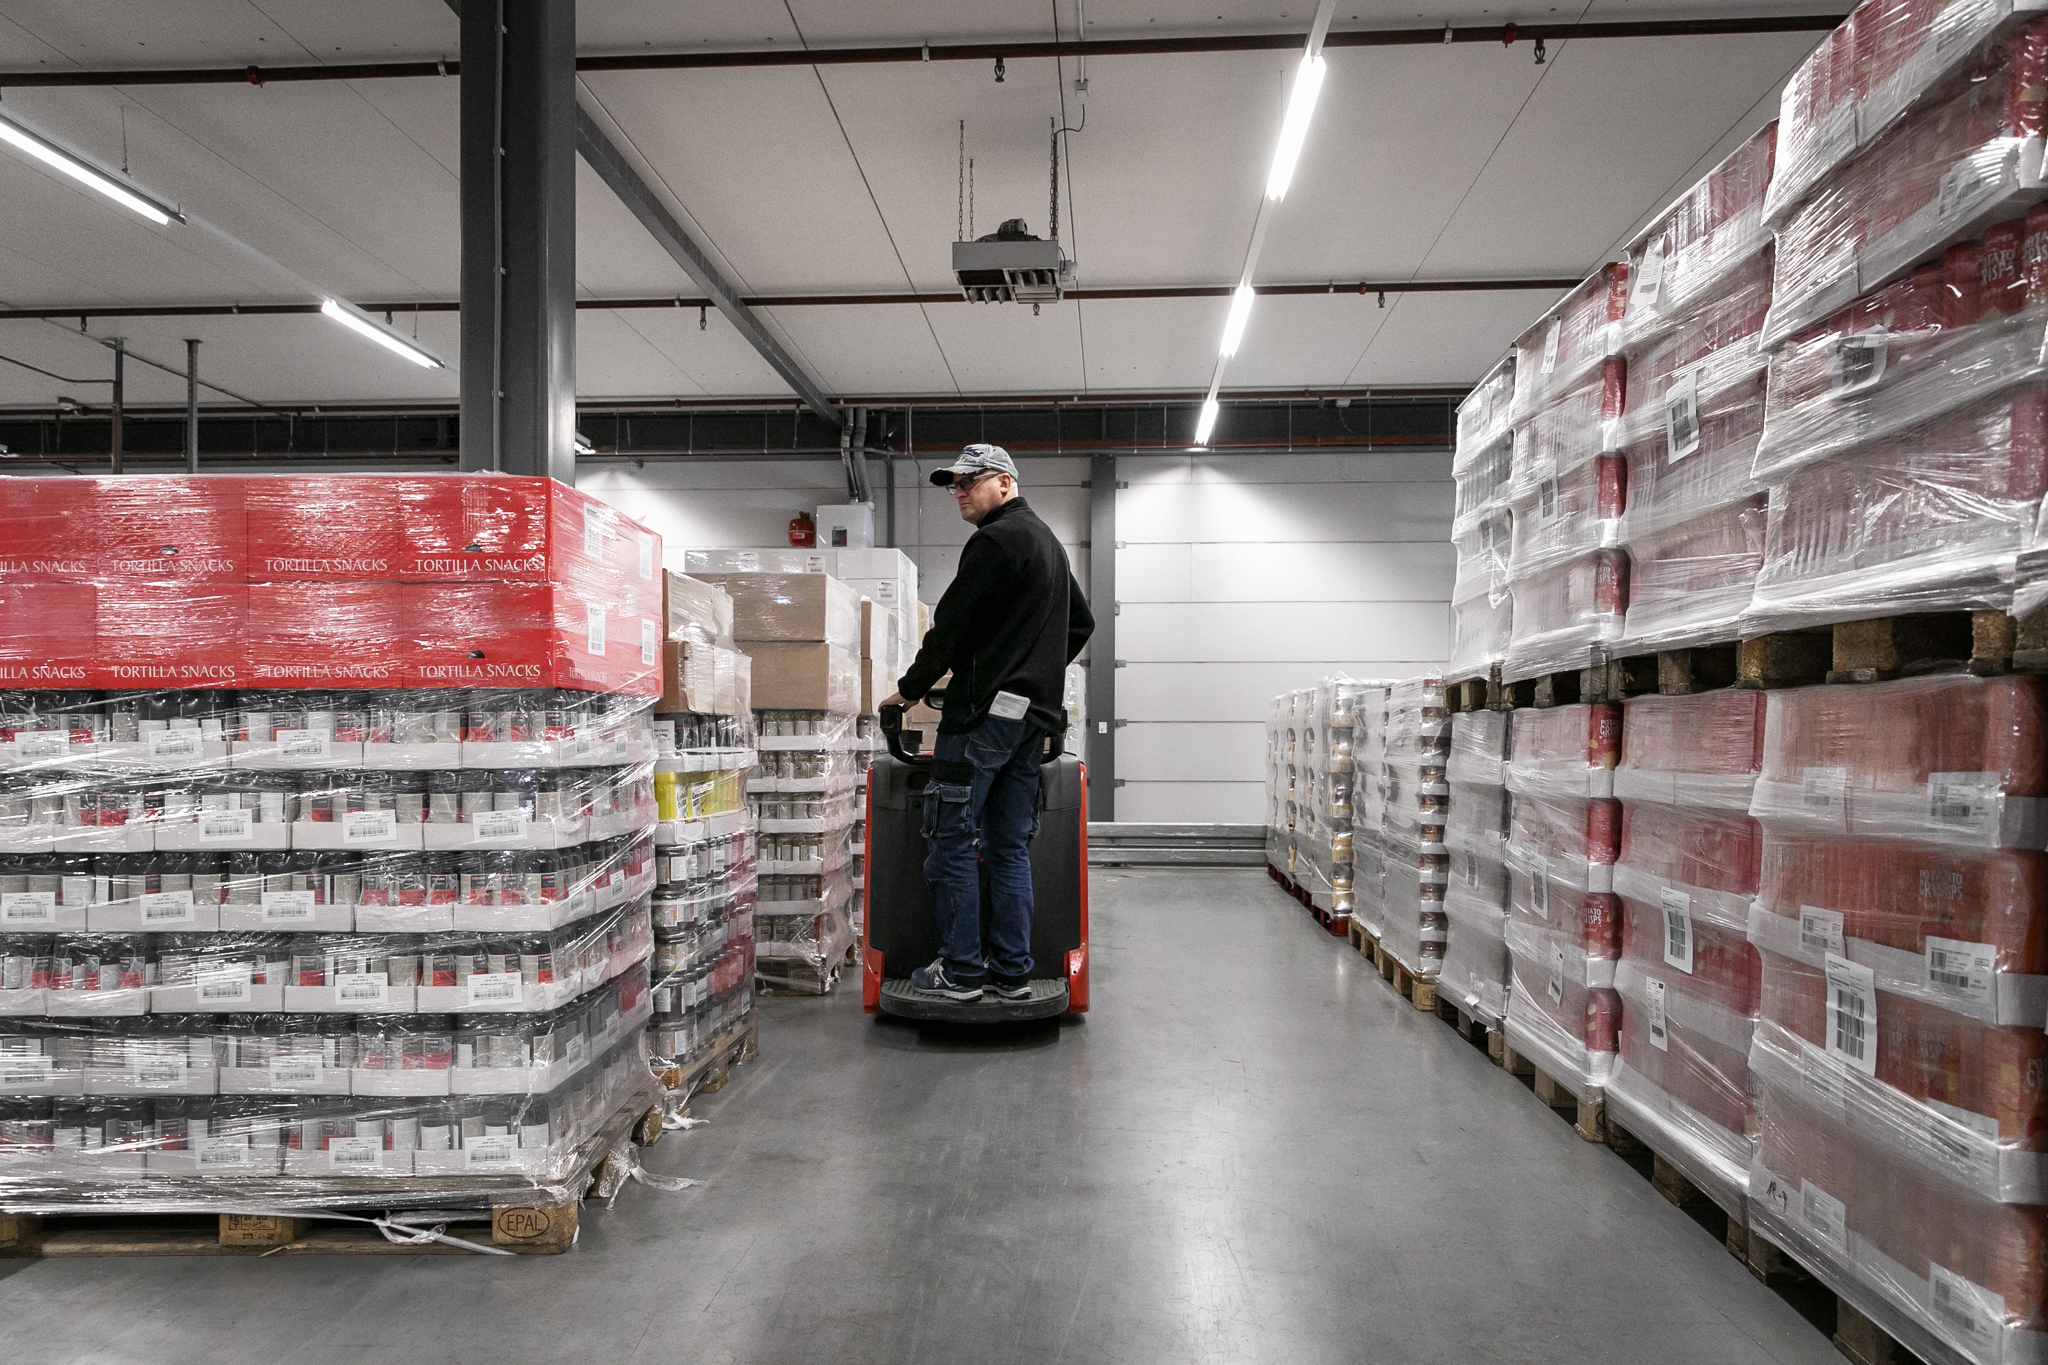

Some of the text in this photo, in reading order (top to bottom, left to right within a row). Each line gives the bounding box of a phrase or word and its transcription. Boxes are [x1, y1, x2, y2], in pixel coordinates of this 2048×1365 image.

[33, 560, 87, 573] SNACKS
[111, 559, 235, 573] TORTILLA SNACKS
[265, 558, 388, 572] TORTILLA SNACKS
[414, 558, 540, 572] TORTILLA SNACKS
[32, 665, 86, 679] SNACKS
[112, 665, 236, 679] TORTILLA SNACKS
[266, 665, 389, 679] TORTILLA SNACKS
[418, 664, 541, 678] TORTILLA SNACKS
[506, 1213, 543, 1232] EPAL
